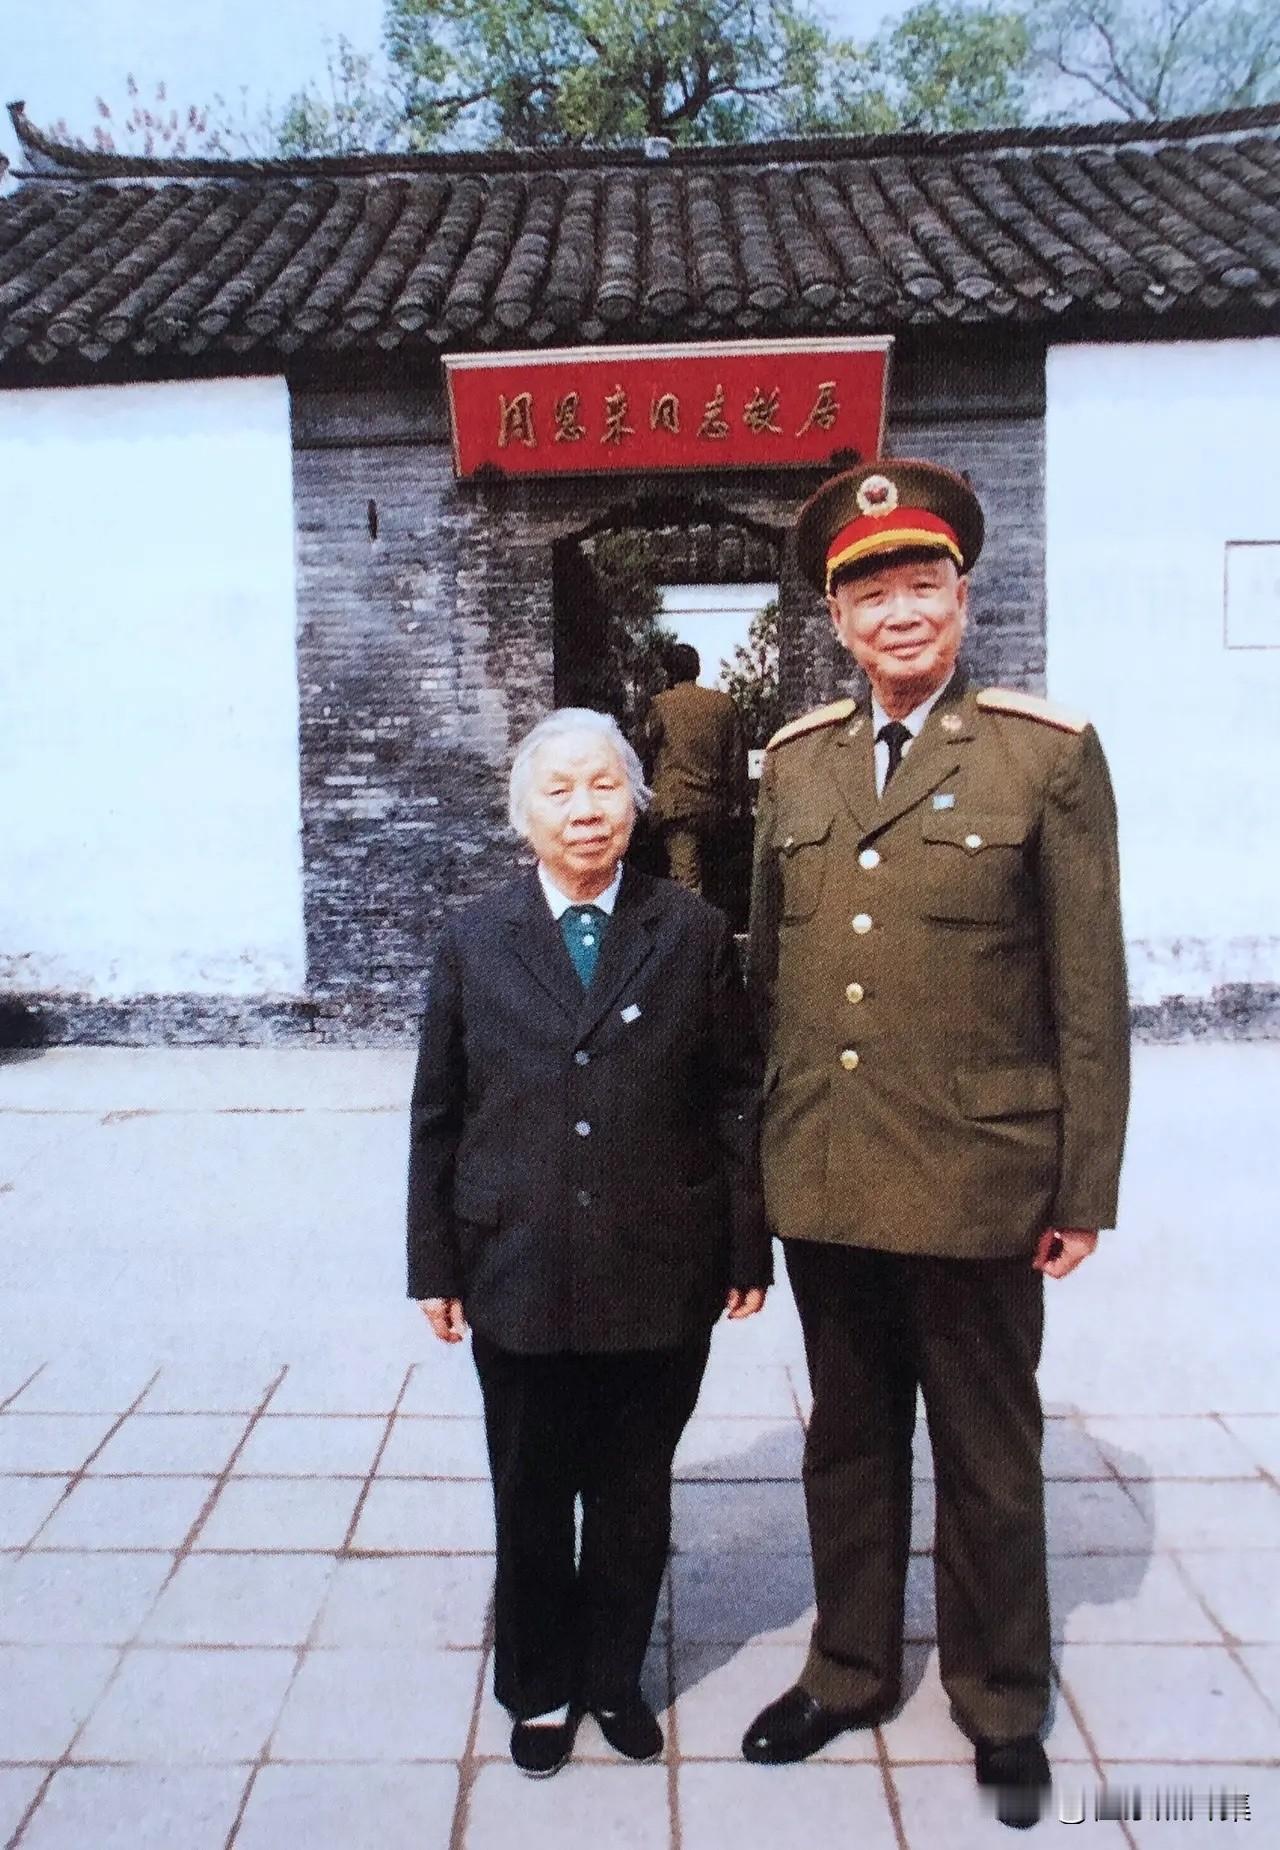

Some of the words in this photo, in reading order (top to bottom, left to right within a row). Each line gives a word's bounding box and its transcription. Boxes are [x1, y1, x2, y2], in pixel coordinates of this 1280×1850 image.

[499, 381, 841, 448] 周恩来同志故居
